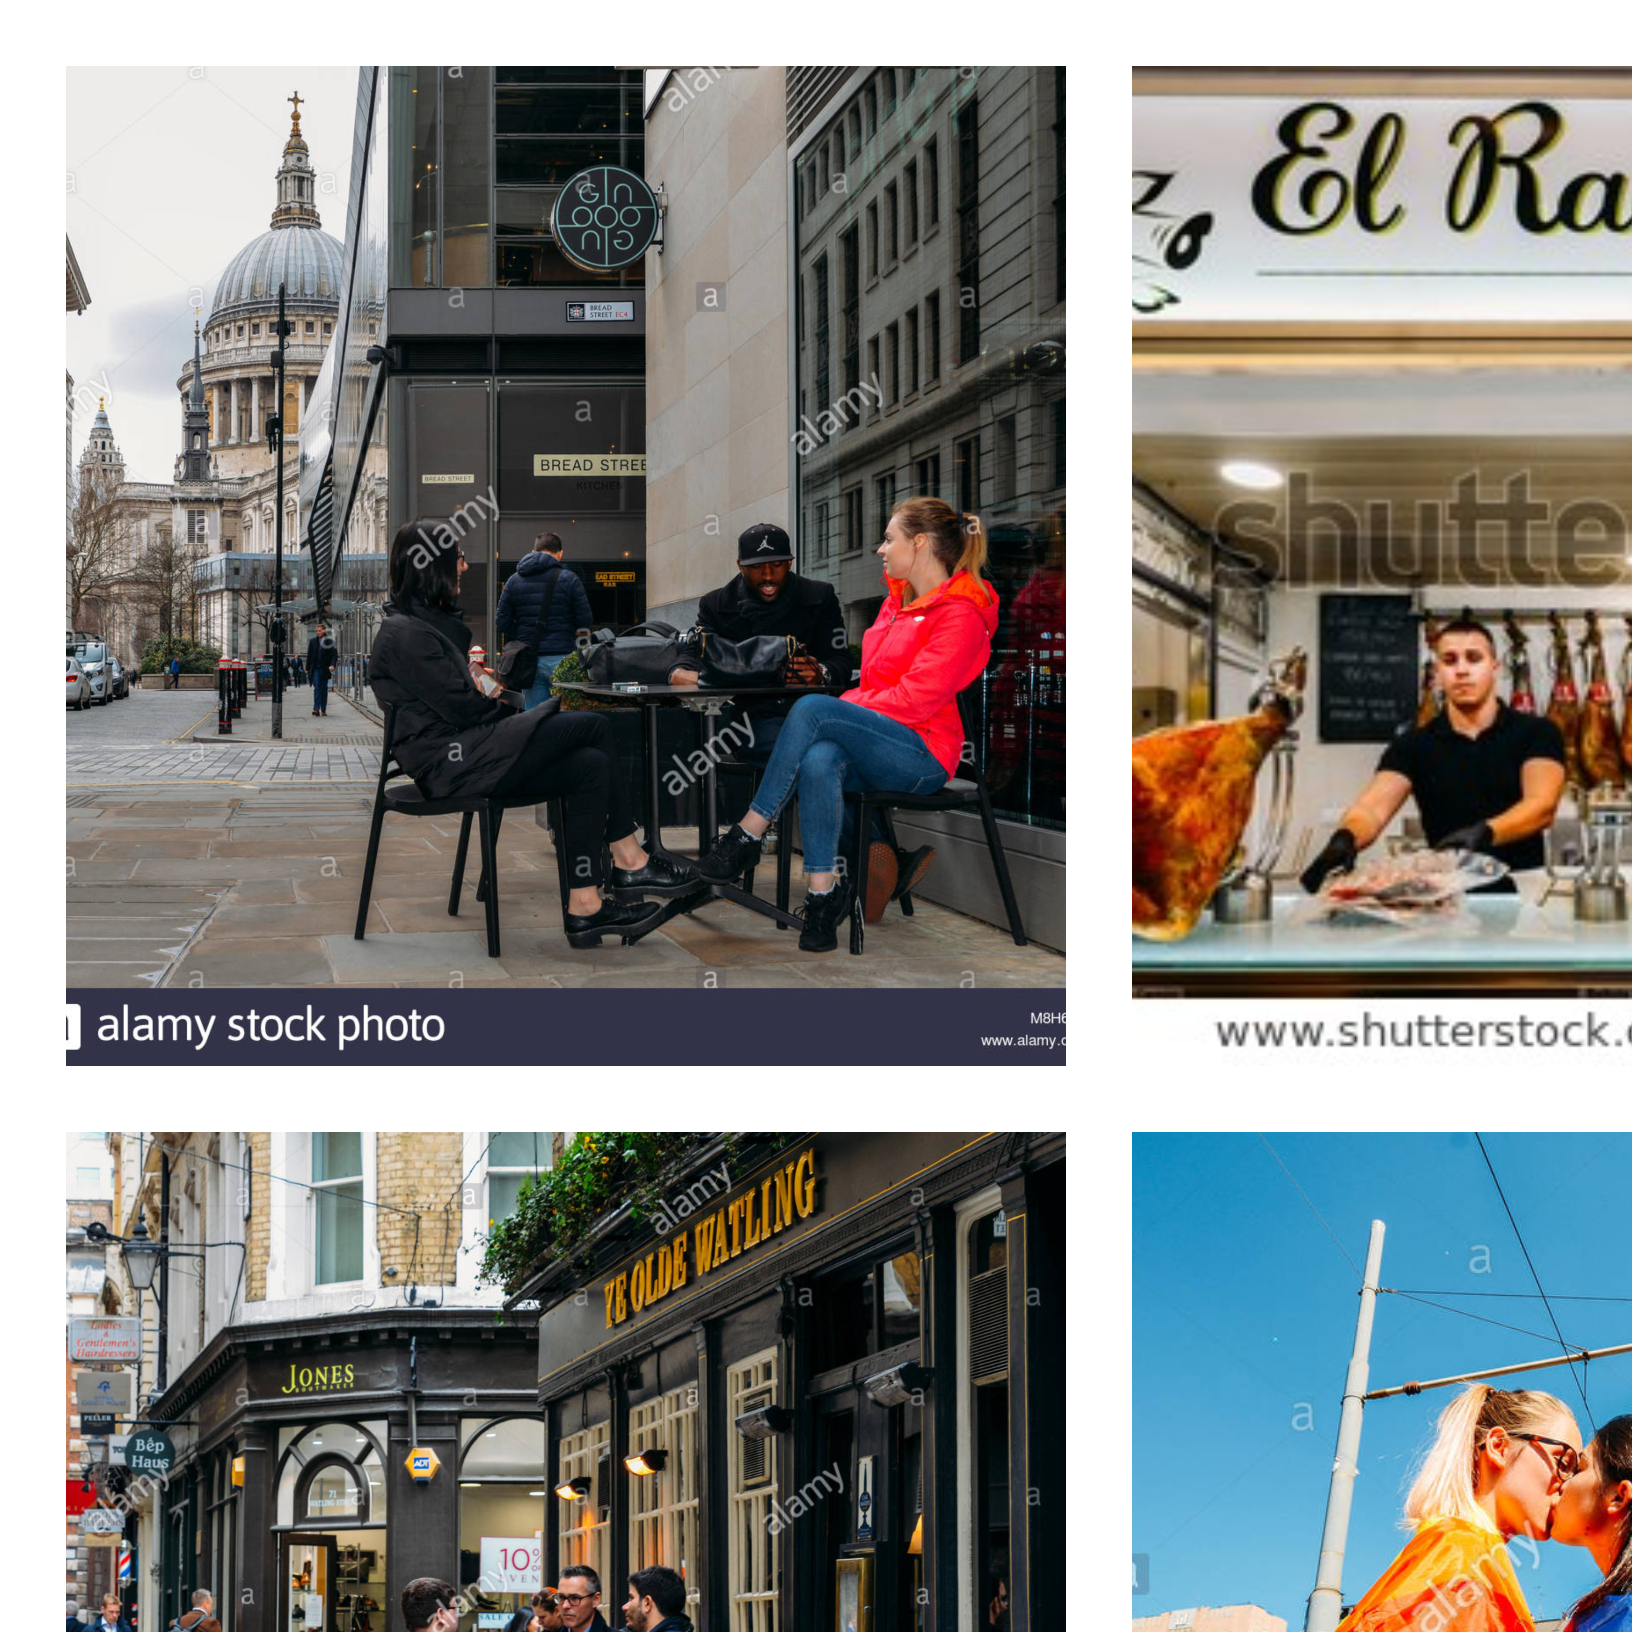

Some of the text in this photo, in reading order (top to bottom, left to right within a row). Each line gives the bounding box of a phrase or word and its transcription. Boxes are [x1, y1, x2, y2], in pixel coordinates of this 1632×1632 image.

[1250, 101, 1406, 236] El
[541, 459, 593, 472] BREAD
[576, 481, 624, 491] KITCHEN
[604, 1148, 816, 1330] YE OLDE WATLING
[90, 1320, 122, 1330] Ladies
[76, 1338, 137, 1347] Gentlemen's
[76, 1348, 137, 1358] Hairdressers
[281, 1363, 355, 1394] JONES
[131, 1455, 170, 1469] Haus
[413, 1459, 430, 1468] ADT
[328, 1489, 337, 1498] 71
